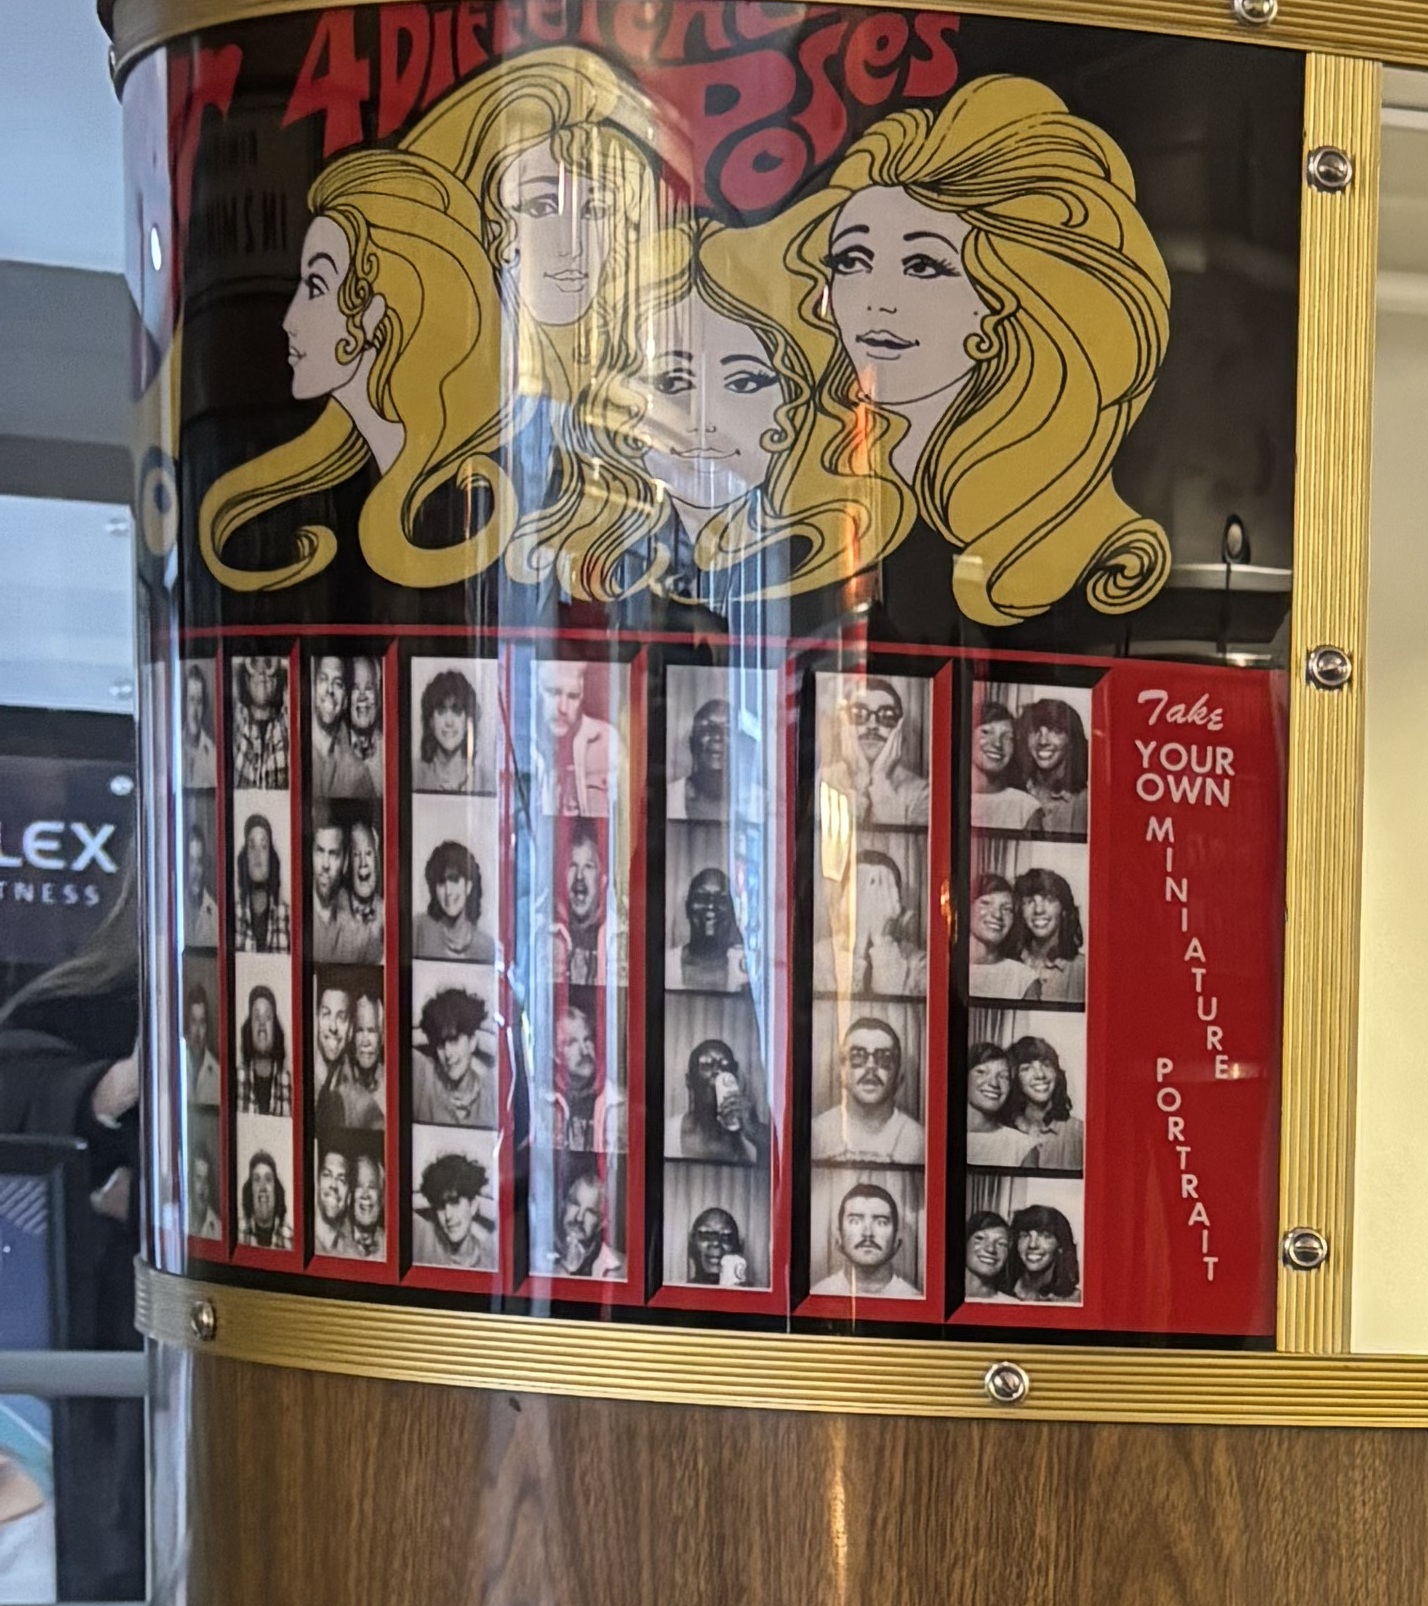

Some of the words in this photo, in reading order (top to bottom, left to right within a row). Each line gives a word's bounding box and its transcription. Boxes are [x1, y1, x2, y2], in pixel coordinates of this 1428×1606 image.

[282, 9, 371, 158] 4
[1137, 689, 1224, 731] Take
[1134, 740, 1236, 776] YOUR
[1136, 772, 1231, 808] OWN
[1146, 816, 1229, 1080] MINIATURE
[1156, 1057, 1219, 1281] PORTRAIT
